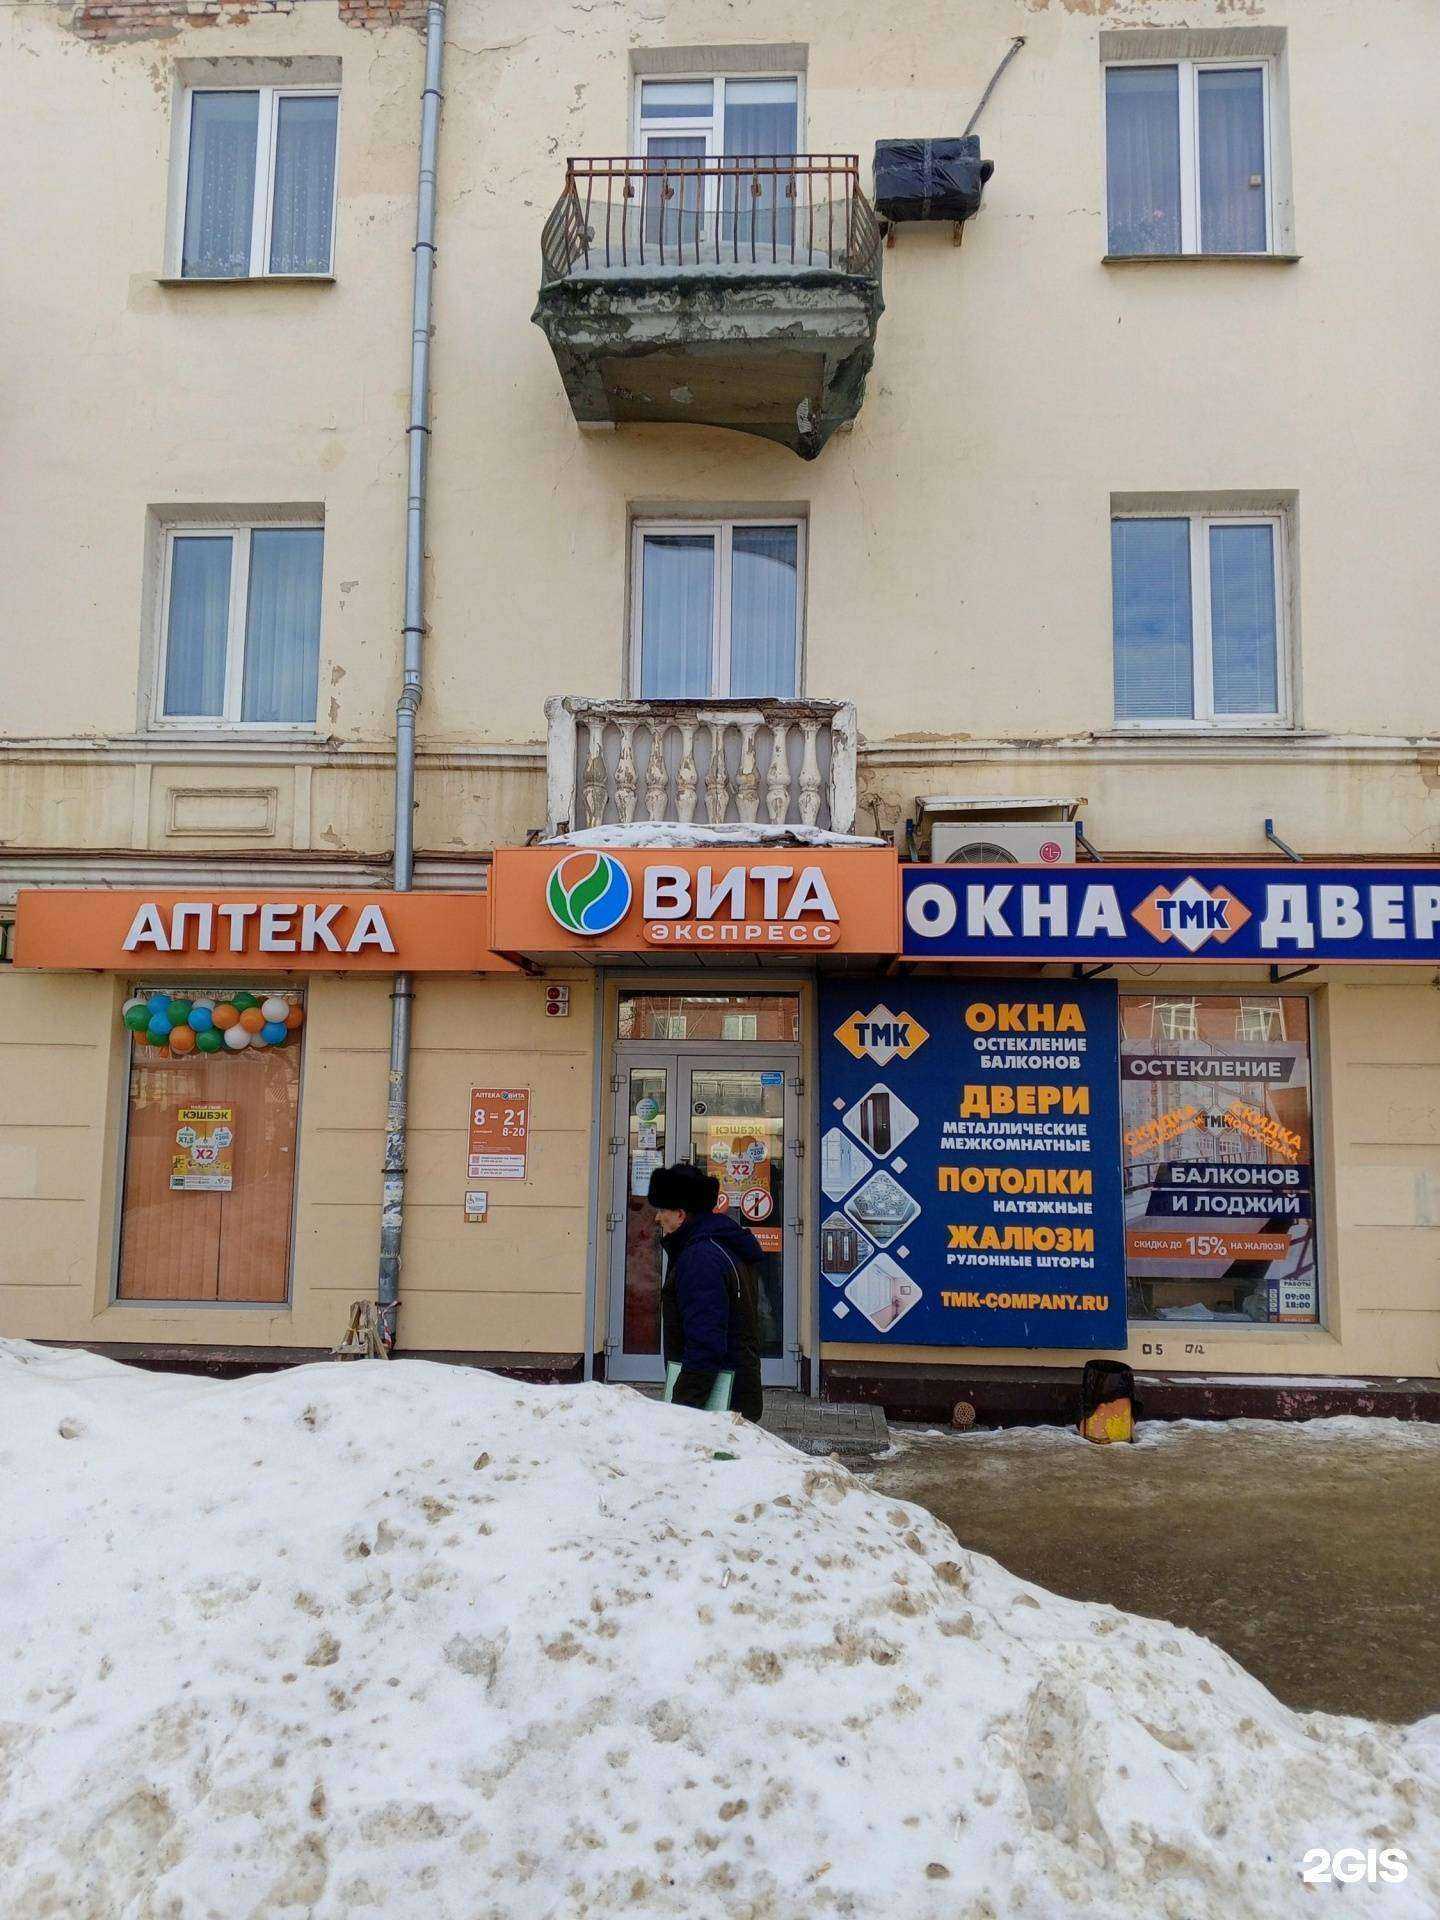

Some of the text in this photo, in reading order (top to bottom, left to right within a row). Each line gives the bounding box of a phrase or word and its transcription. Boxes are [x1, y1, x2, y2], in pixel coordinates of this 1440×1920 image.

[643, 865, 841, 921] ВИТА
[906, 883, 1440, 949] ОКНА ТМК ДВЕР
[121, 902, 396, 953] АПТЕКА
[651, 924, 832, 942] ЭКСПРЕСС
[965, 1003, 1087, 1032] ОКНА
[854, 1023, 911, 1047] ТМК
[973, 1037, 1087, 1051] ОСТЕКЛЕНИЕ
[980, 1055, 1081, 1069] БАЛКОНОВ
[1130, 1059, 1282, 1077] ОСТЕКЛЕНИЕ
[959, 1084, 1090, 1119] ДВЕРИ
[183, 1111, 229, 1120] КЭШБЭК
[503, 1109, 526, 1126] 21
[502, 1127, 525, 1137] 8-20
[716, 1126, 762, 1135] КЭШБЭК
[943, 1121, 1087, 1136] МЕТАЛЛИЧЕСКИЕ
[940, 1137, 1091, 1152] МЕЖКОМНАТНЫЕ
[938, 1166, 1093, 1195] ПОТОЛКИ
[1171, 1167, 1300, 1185] БАЛКОНОВ
[993, 1200, 1093, 1215] НАТЯЖНЫЕ
[1172, 1193, 1300, 1215] И ЛОДЖИЙ
[947, 1224, 1095, 1252] ЖАЛЮЗИ
[1134, 1236, 1285, 1256] СКИДКА ДО 15% НА ЖАЛЮЗИ
[947, 1254, 1095, 1269] РУЛОННЫЕ ШТОРЫ
[940, 1291, 1109, 1311] TMK-COMPANY.RU
[1284, 1293, 1311, 1301] 09:00
[1285, 1301, 1311, 1309] 18:00
